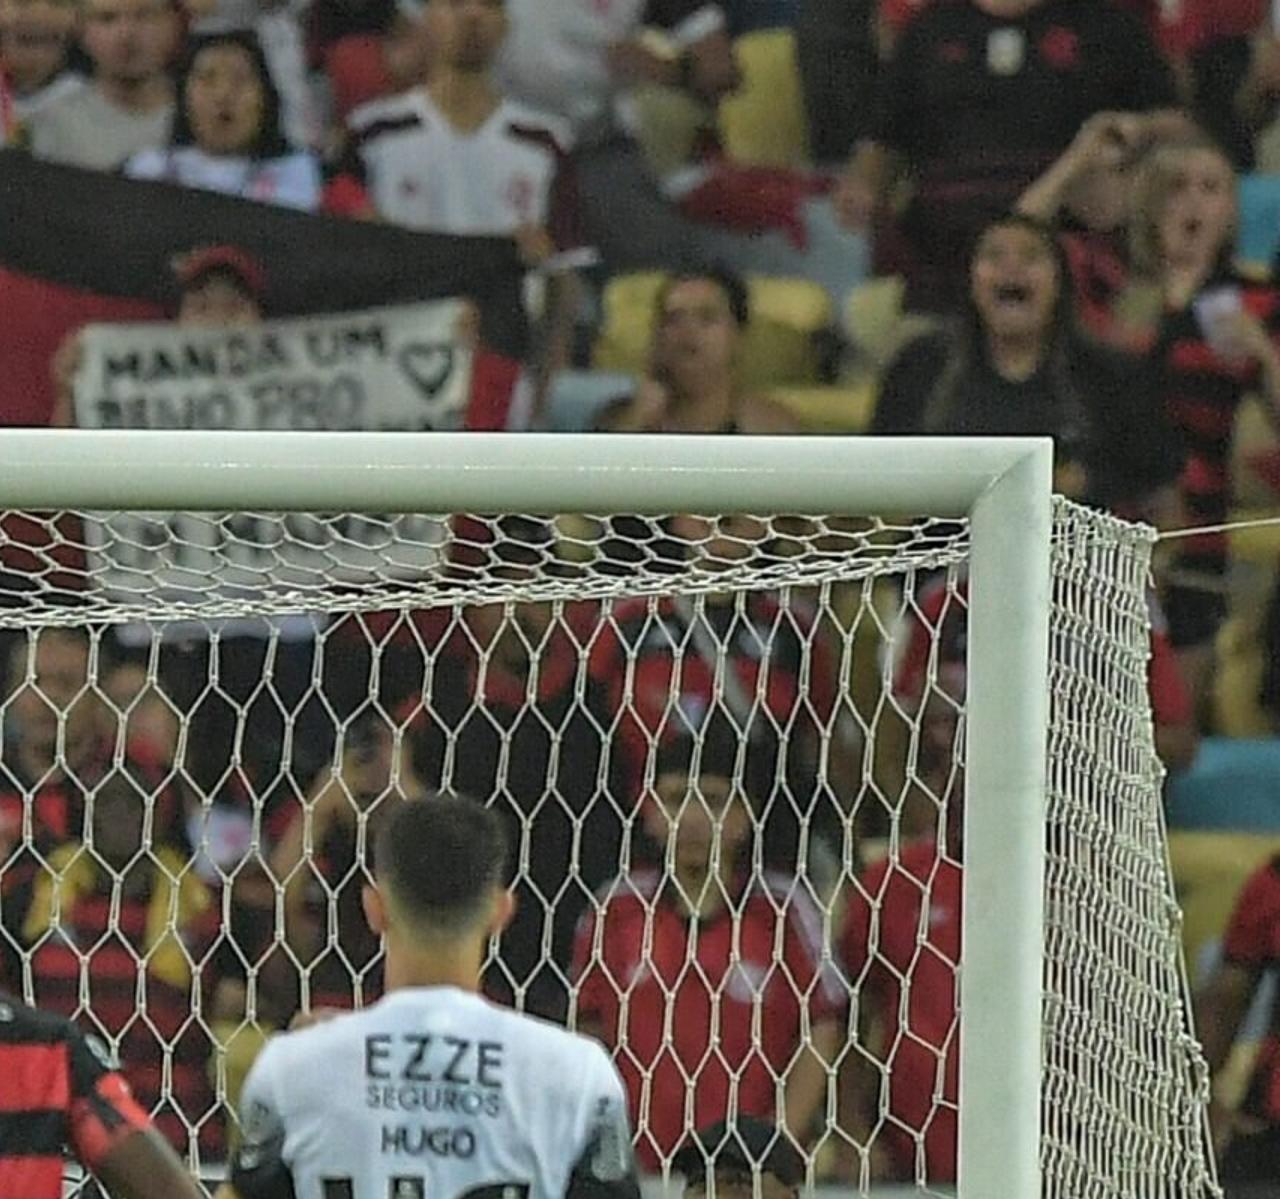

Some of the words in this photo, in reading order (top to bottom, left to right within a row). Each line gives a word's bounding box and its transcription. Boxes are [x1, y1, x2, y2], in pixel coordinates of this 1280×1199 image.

[104, 334, 286, 379] MANDA
[306, 324, 385, 364] UM
[364, 1033, 504, 1087] EZZE
[366, 1087, 501, 1118] SEGUROS
[382, 1124, 476, 1159] HUGO
